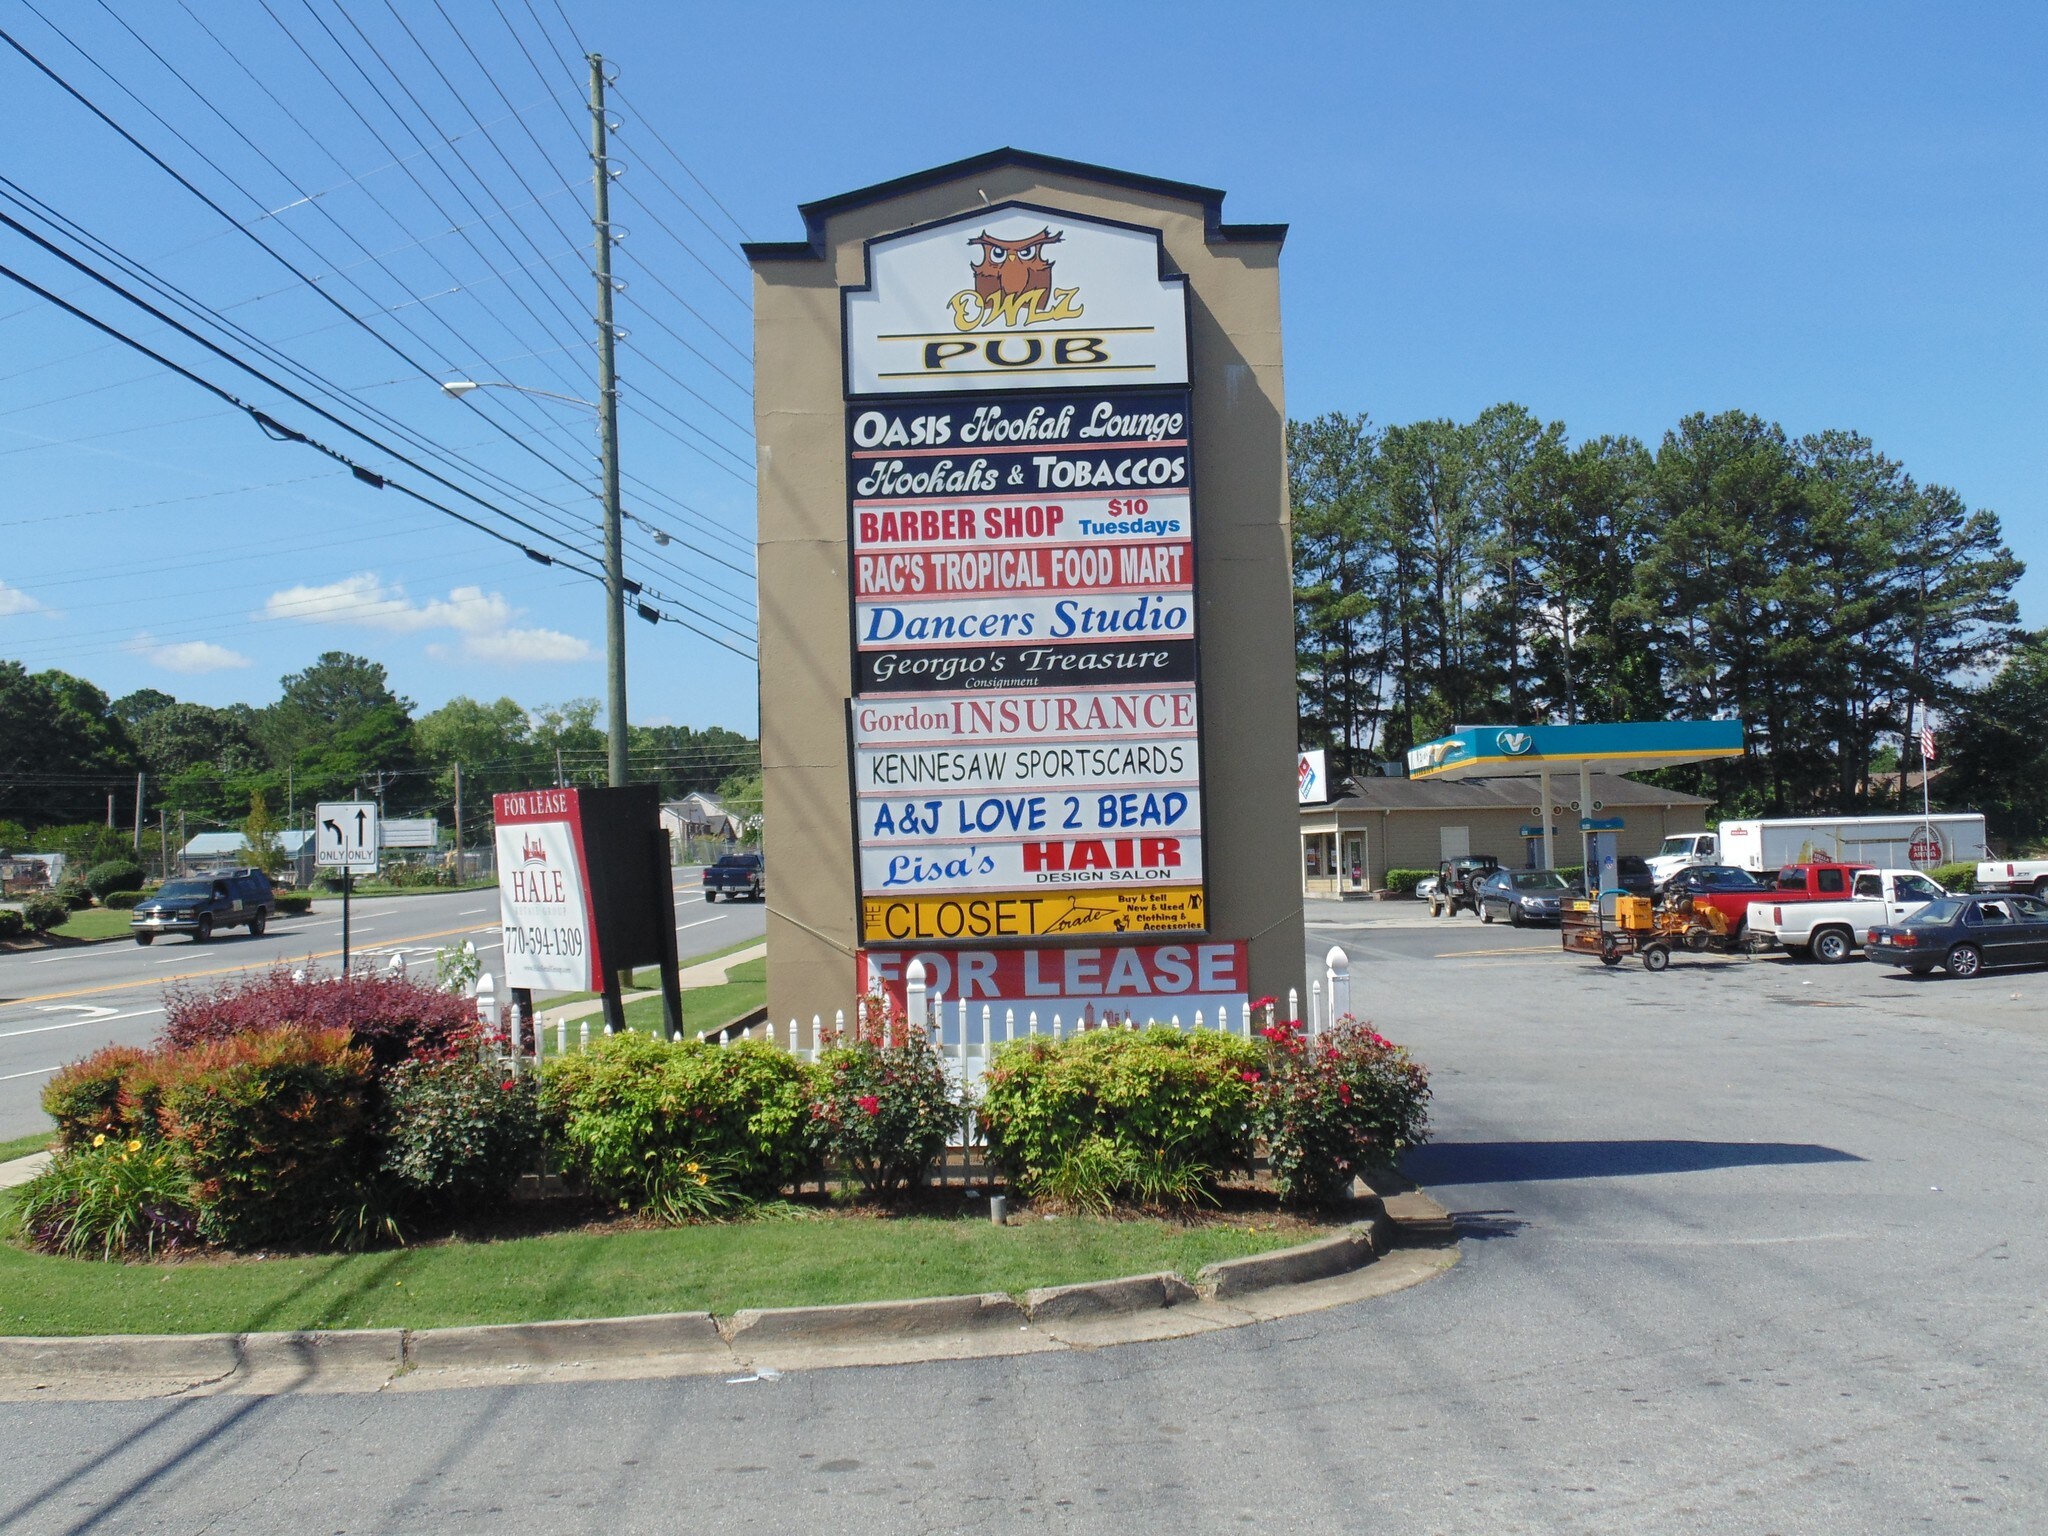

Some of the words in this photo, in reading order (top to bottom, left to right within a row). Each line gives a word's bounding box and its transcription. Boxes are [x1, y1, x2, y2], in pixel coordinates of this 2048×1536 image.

[922, 336, 1111, 369] PUB
[853, 411, 951, 448] OASIS
[959, 404, 1076, 443] Hookah
[1079, 401, 1184, 442] Lounge
[856, 458, 1000, 496] Hookahs
[1007, 464, 1025, 486] &
[1032, 456, 1186, 489] TOBACCOS
[859, 508, 976, 544] BARBER
[984, 505, 1064, 539] SHOP
[1107, 498, 1149, 518] $10
[1078, 518, 1181, 538] Tuesdays
[859, 554, 925, 593] RAC'S
[931, 549, 1045, 591] TROPICAL
[1051, 548, 1113, 587] FOOD
[1120, 546, 1184, 584] MART
[863, 607, 1035, 642] Dancers
[1050, 595, 1188, 638] Studio
[872, 651, 1006, 682] Georgio's
[1018, 647, 1170, 672] Treasure
[965, 676, 1040, 690] Consignment
[859, 705, 950, 734] Gordon
[950, 693, 1195, 735] INSURANCE
[872, 751, 1008, 785] KENNESAW
[1015, 745, 1184, 780] SPORTSCARDS
[503, 796, 528, 817] FOR
[530, 793, 568, 815] LEASE
[873, 800, 944, 837] A&J
[958, 796, 1047, 835] LOVE
[1062, 796, 1083, 829] 2
[1097, 791, 1189, 828] BEAD
[319, 850, 345, 861] ONLY
[348, 850, 373, 860] ONLY
[882, 845, 996, 888] Lisa's
[1021, 837, 1182, 873] HAIR
[511, 870, 566, 904] HALE
[1036, 871, 1104, 884] DESIGN
[1108, 868, 1172, 882] SALON
[1118, 894, 1138, 904] Buy
[1140, 894, 1147, 902] &
[1149, 893, 1168, 902] Sell
[1126, 903, 1149, 912] New
[1151, 903, 1158, 911] &
[1159, 902, 1185, 911] Used
[865, 904, 881, 930] THE
[884, 898, 1044, 940] CLOSET
[1136, 912, 1178, 922] Clothing
[1180, 911, 1187, 920] &
[1143, 921, 1202, 931] Accessories
[504, 926, 583, 957] 770-594-1309
[867, 950, 1002, 999] FOR
[1023, 943, 1238, 998] LEASE
